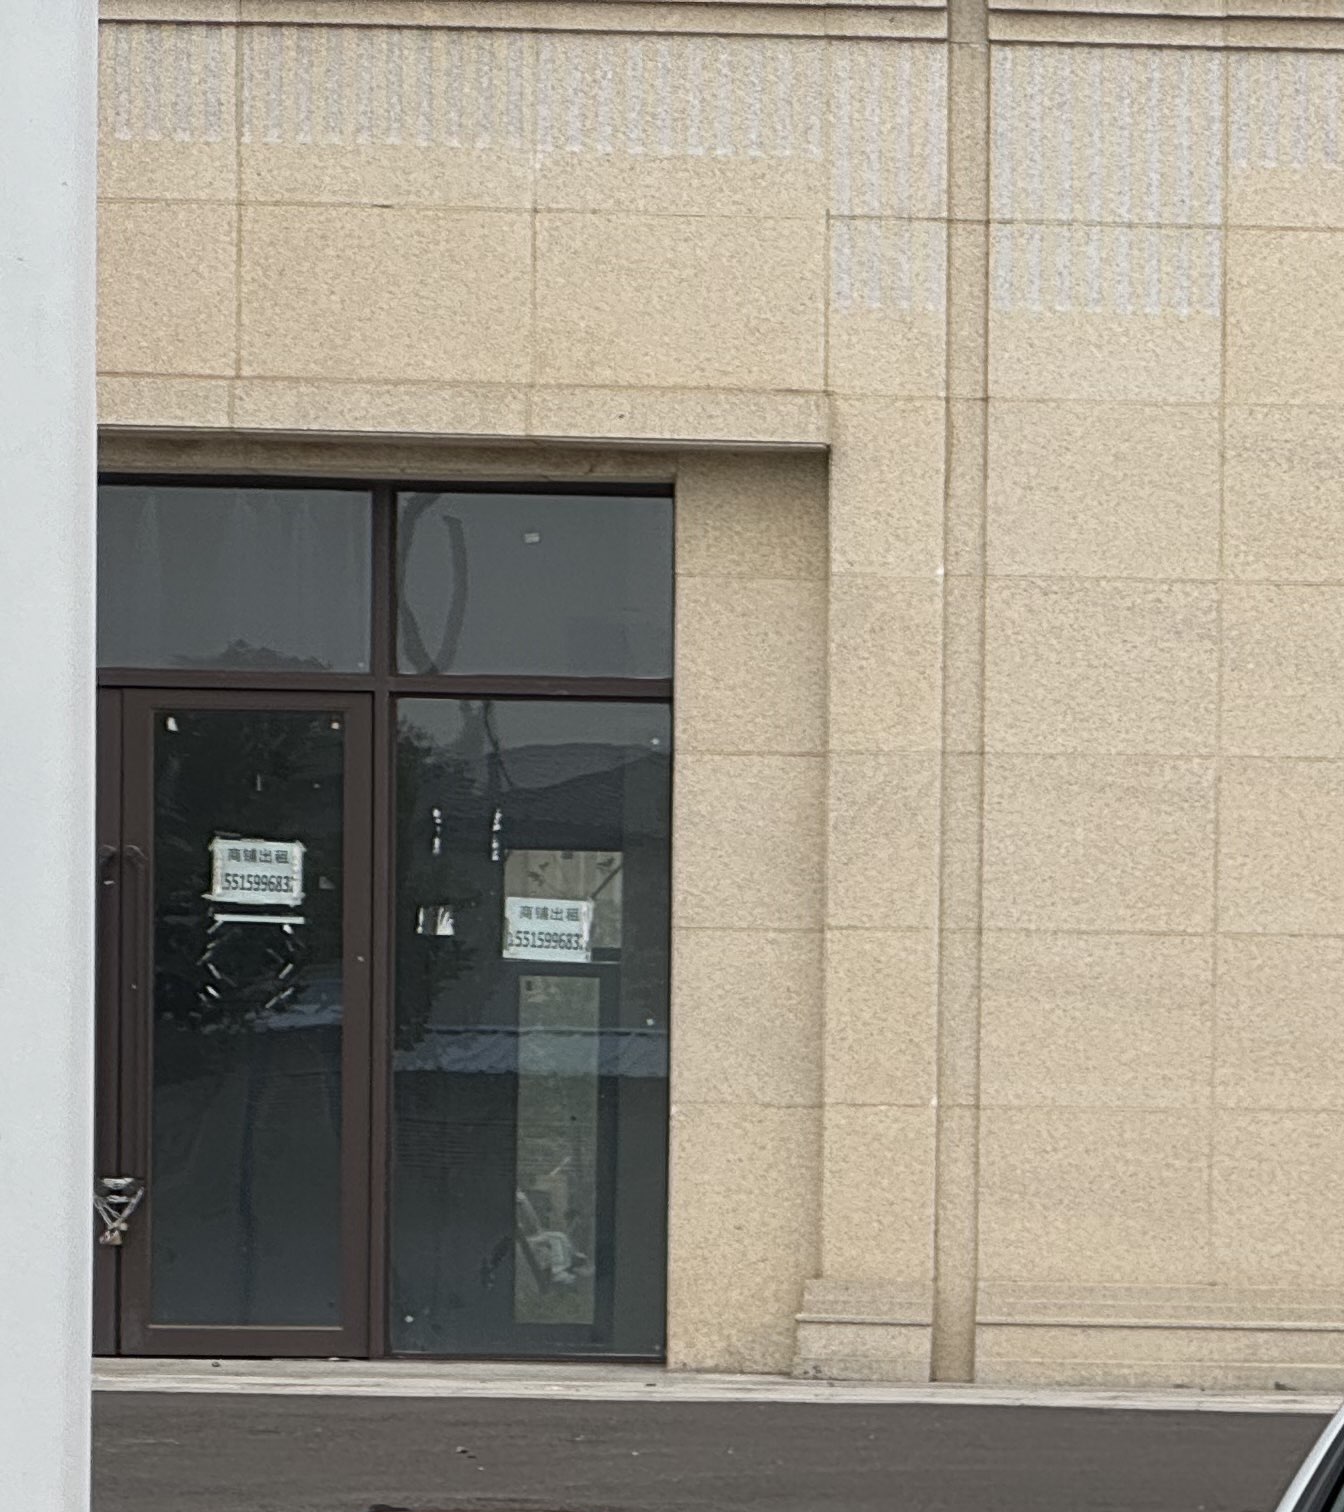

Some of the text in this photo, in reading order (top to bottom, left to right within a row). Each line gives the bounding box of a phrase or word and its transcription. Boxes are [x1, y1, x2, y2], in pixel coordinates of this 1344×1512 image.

[227, 848, 289, 864] 商铺出租
[519, 905, 580, 921] 商铺出租
